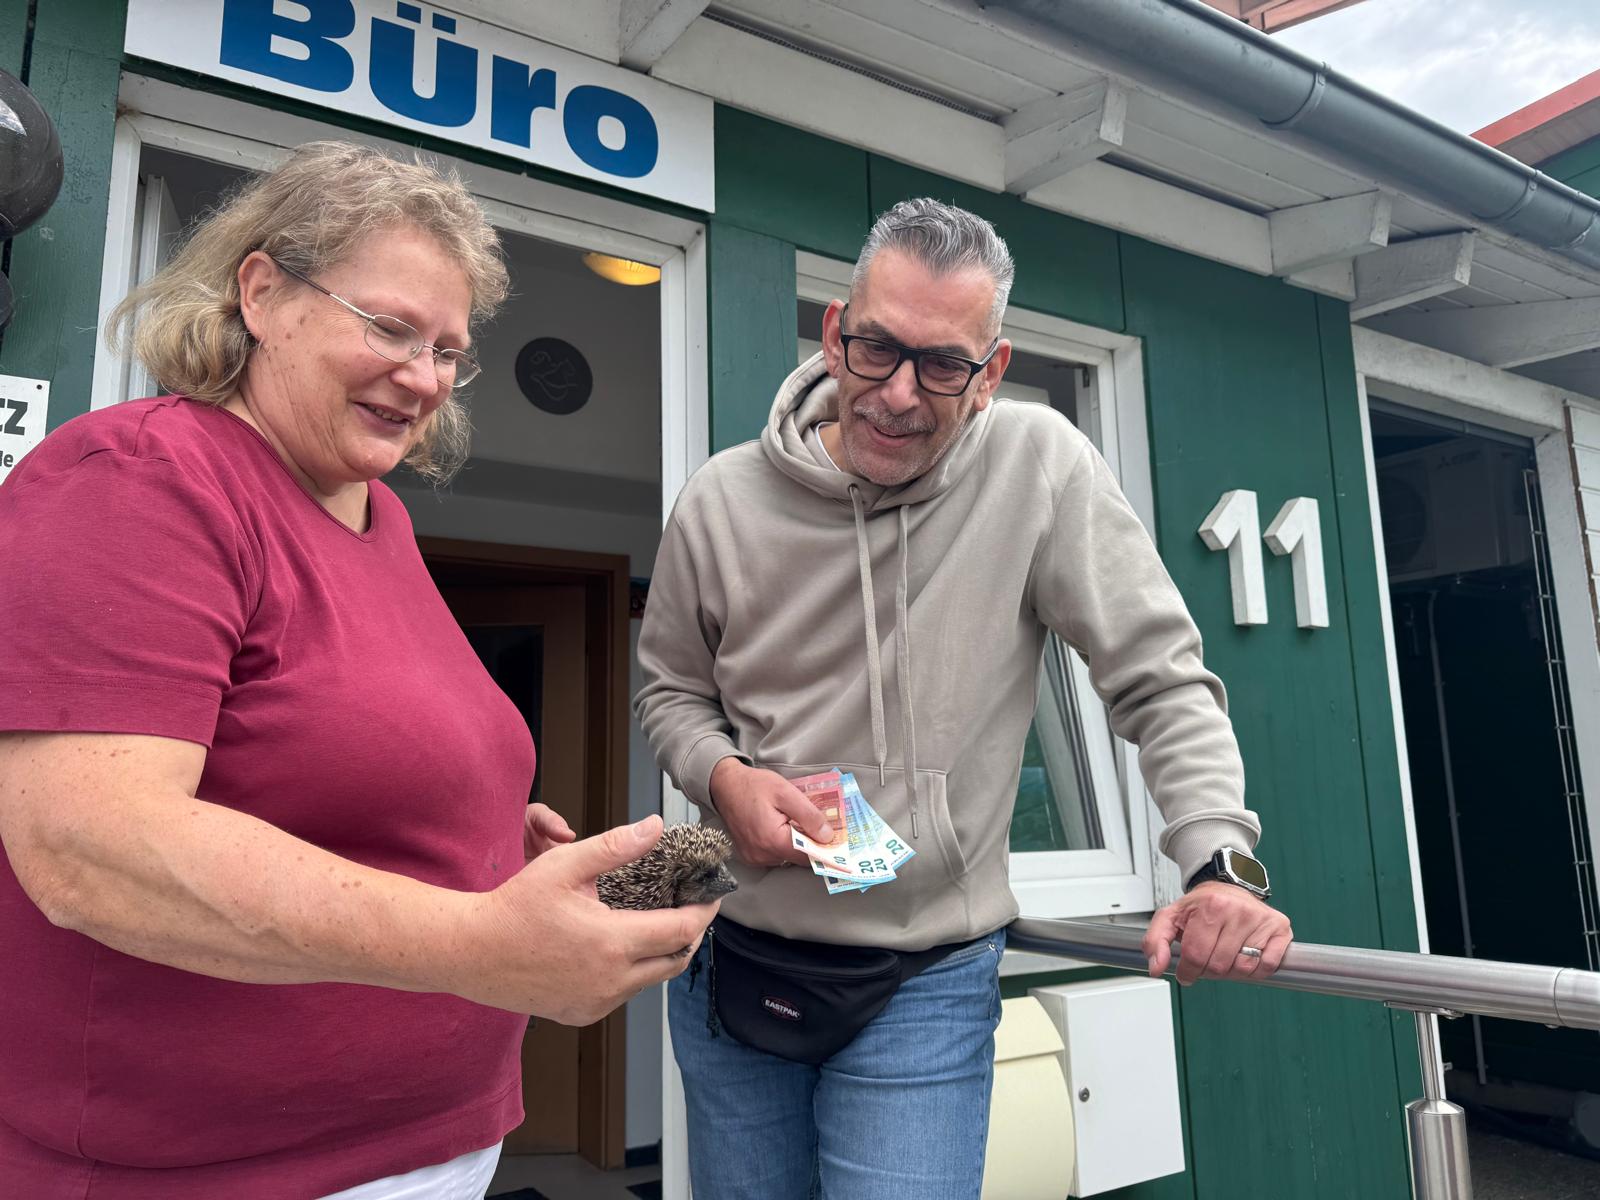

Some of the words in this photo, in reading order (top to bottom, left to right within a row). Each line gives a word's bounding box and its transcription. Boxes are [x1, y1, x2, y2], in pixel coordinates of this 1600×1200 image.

[220, 0, 658, 178] Büro
[1198, 489, 1329, 627] 11
[858, 860, 874, 873] 20
[885, 839, 904, 855] 20
